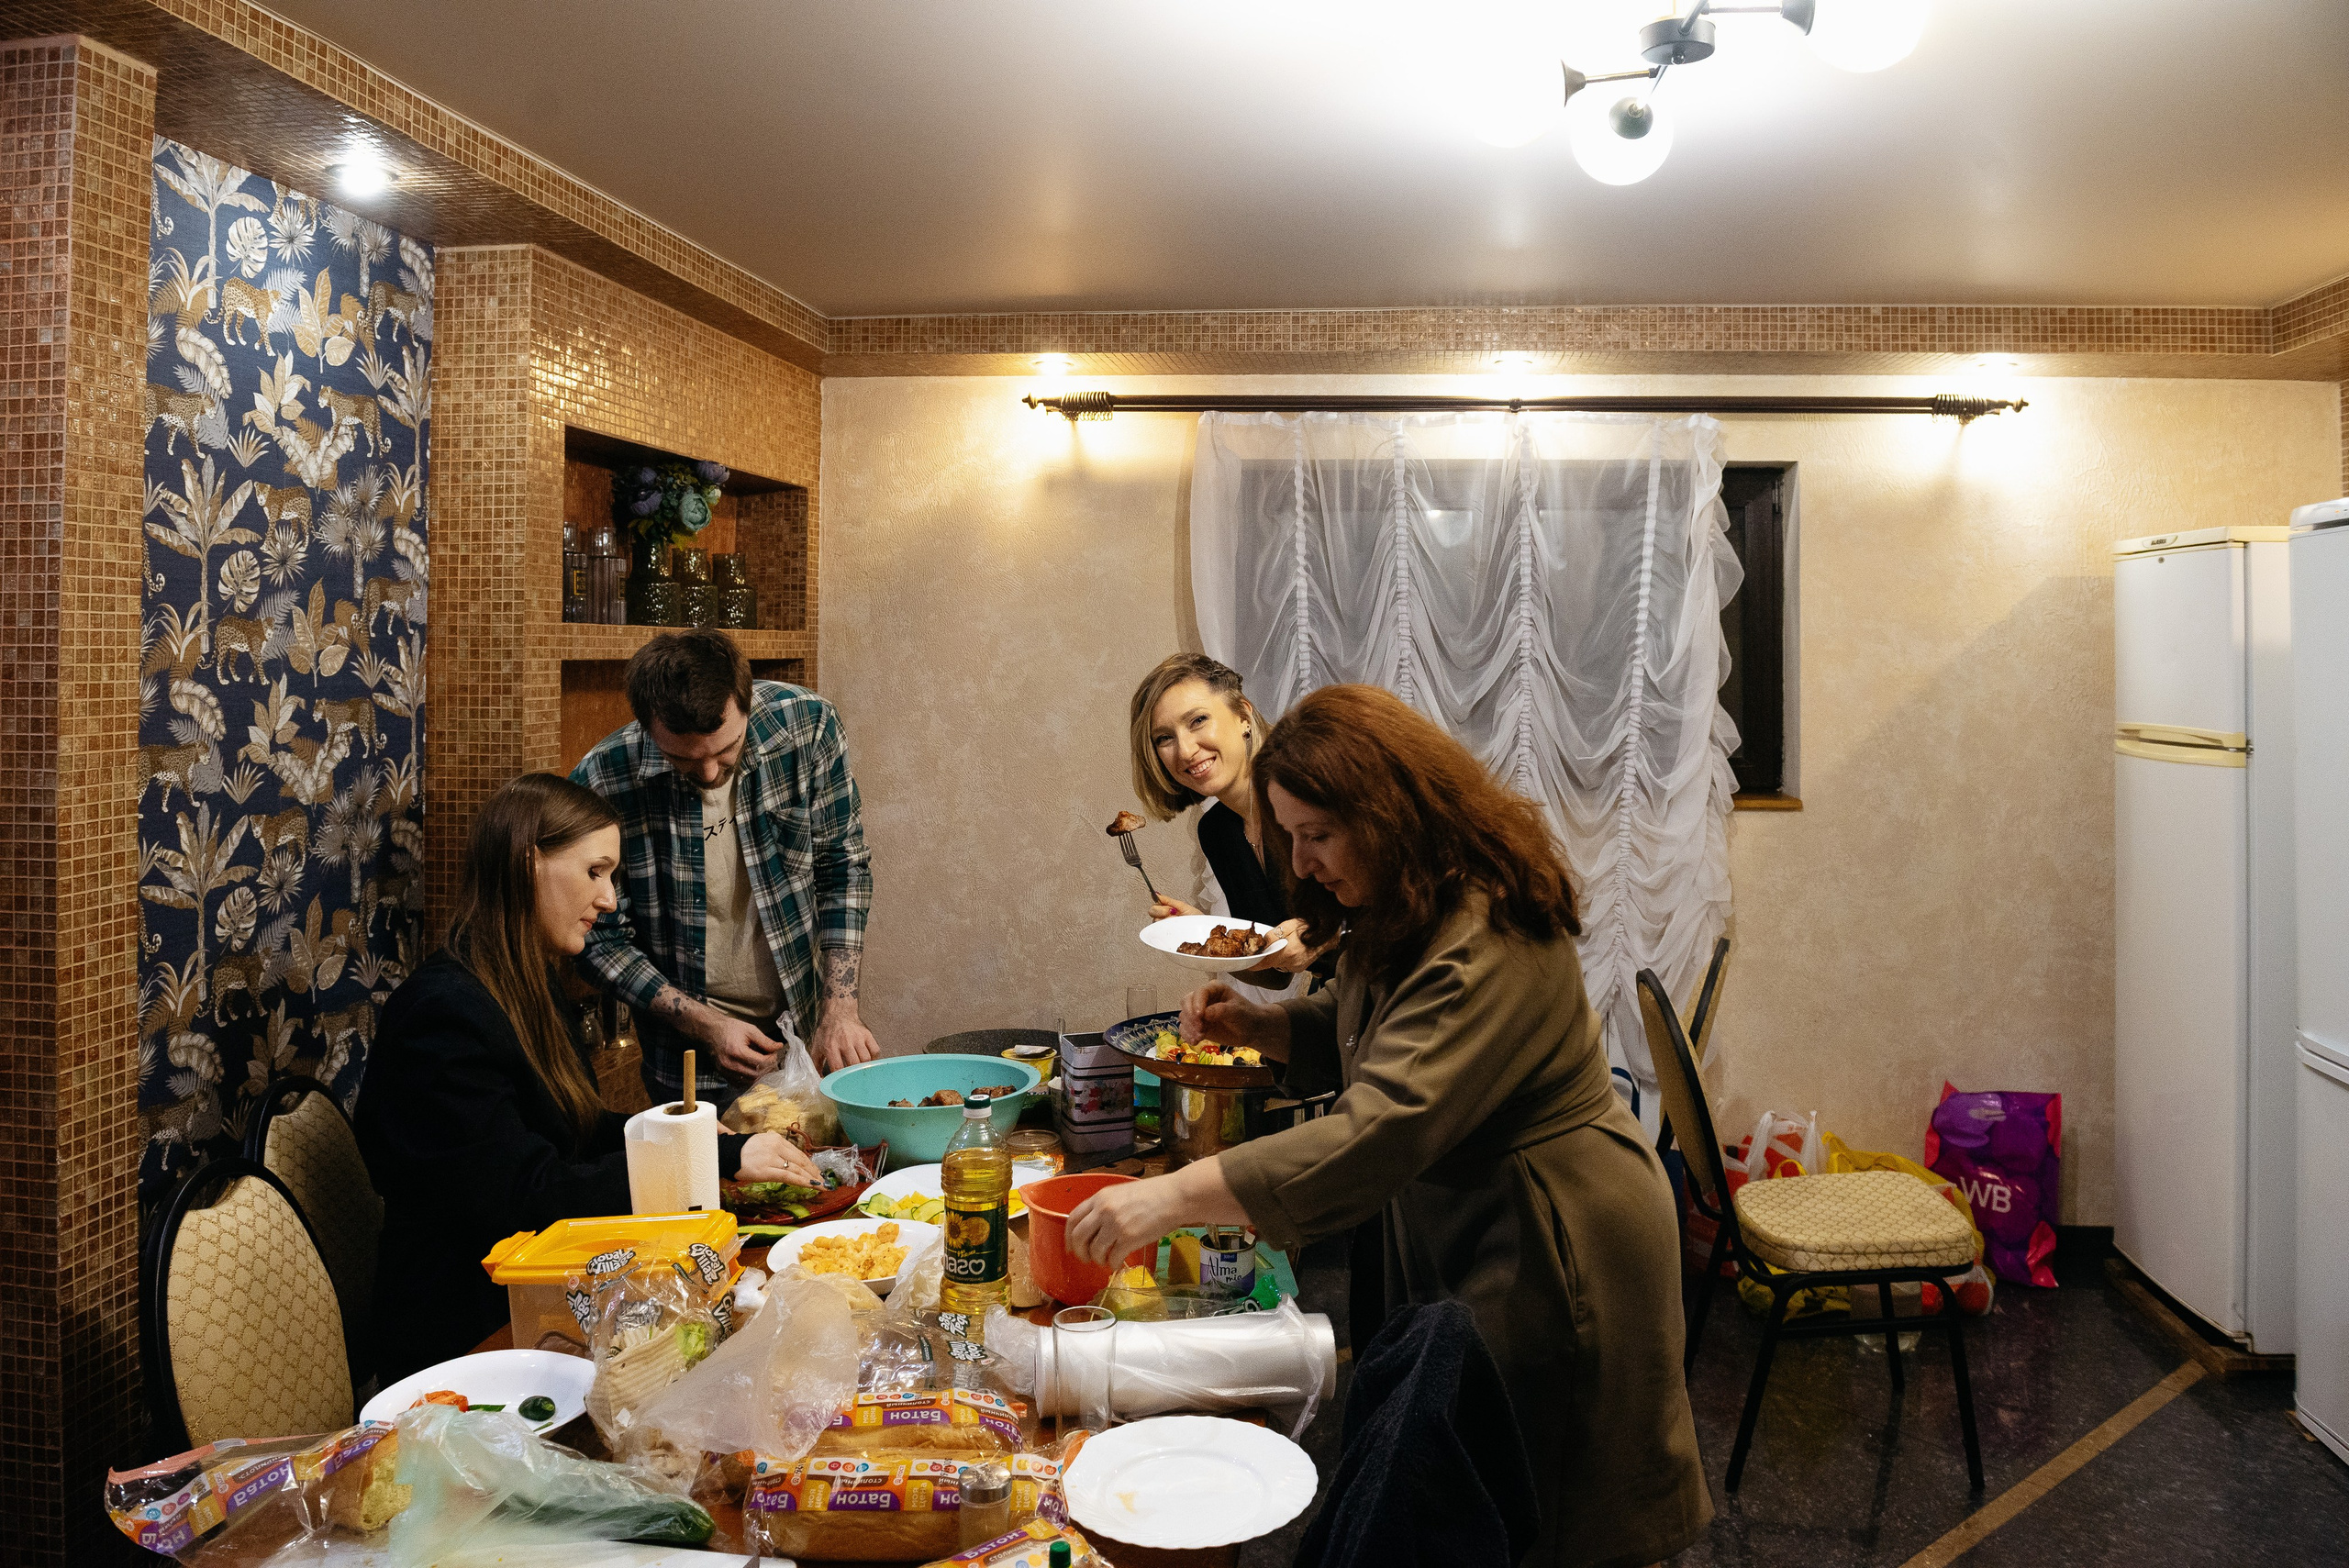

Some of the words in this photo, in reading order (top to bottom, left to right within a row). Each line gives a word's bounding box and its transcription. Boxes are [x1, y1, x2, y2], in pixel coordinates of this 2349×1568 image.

[1959, 1176, 2012, 1213] WB
[587, 1249, 625, 1274] Global
[1206, 1255, 1238, 1277] Alma
[1226, 1274, 1242, 1284] mia
[890, 1410, 941, 1421] Батон
[836, 1493, 891, 1508] Батон
[963, 1530, 1019, 1559] Батон
[988, 1540, 1034, 1562] столичный
